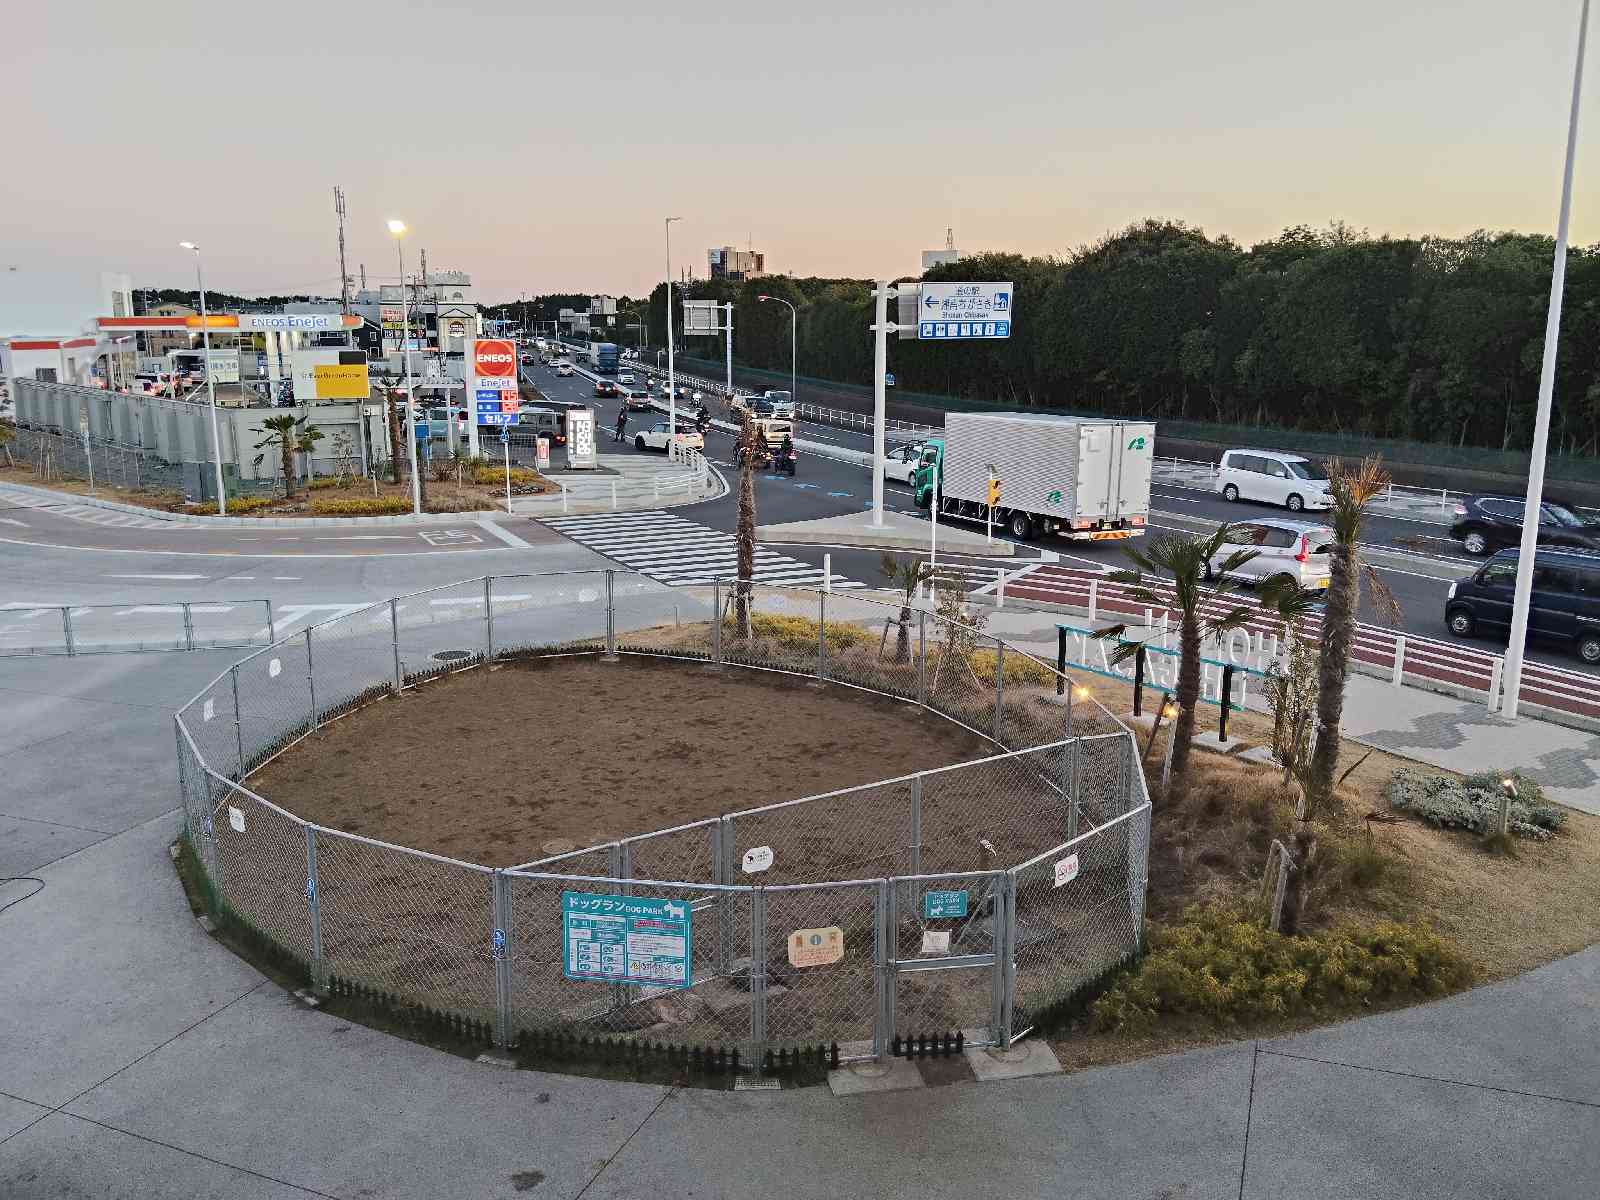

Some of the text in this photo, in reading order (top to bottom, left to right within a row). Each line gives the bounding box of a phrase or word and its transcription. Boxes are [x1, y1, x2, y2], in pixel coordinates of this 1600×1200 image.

[251, 318, 286, 327] ENEOS
[476, 353, 513, 363] ENEOS
[484, 414, 512, 424] セルフ
[569, 896, 663, 915] ドッグラン DOG PARK
